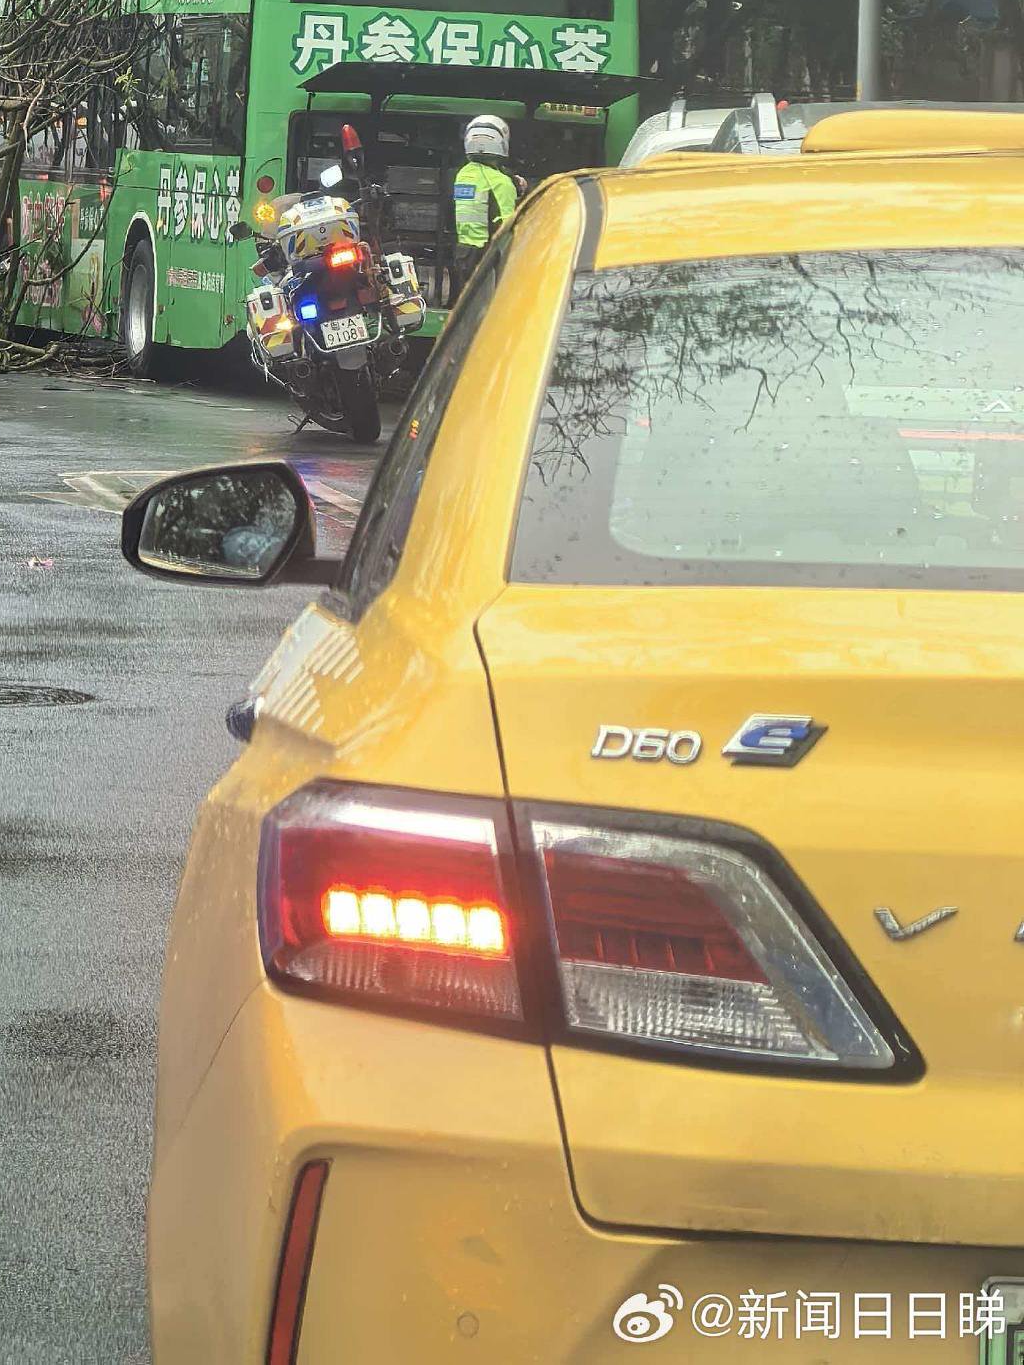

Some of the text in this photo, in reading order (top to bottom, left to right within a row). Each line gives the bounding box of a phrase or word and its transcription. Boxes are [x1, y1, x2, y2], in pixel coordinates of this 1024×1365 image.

[294, 11, 609, 74] 丹参保心茶
[155, 164, 241, 243] 丹参保心茶
[591, 723, 703, 765] D60
